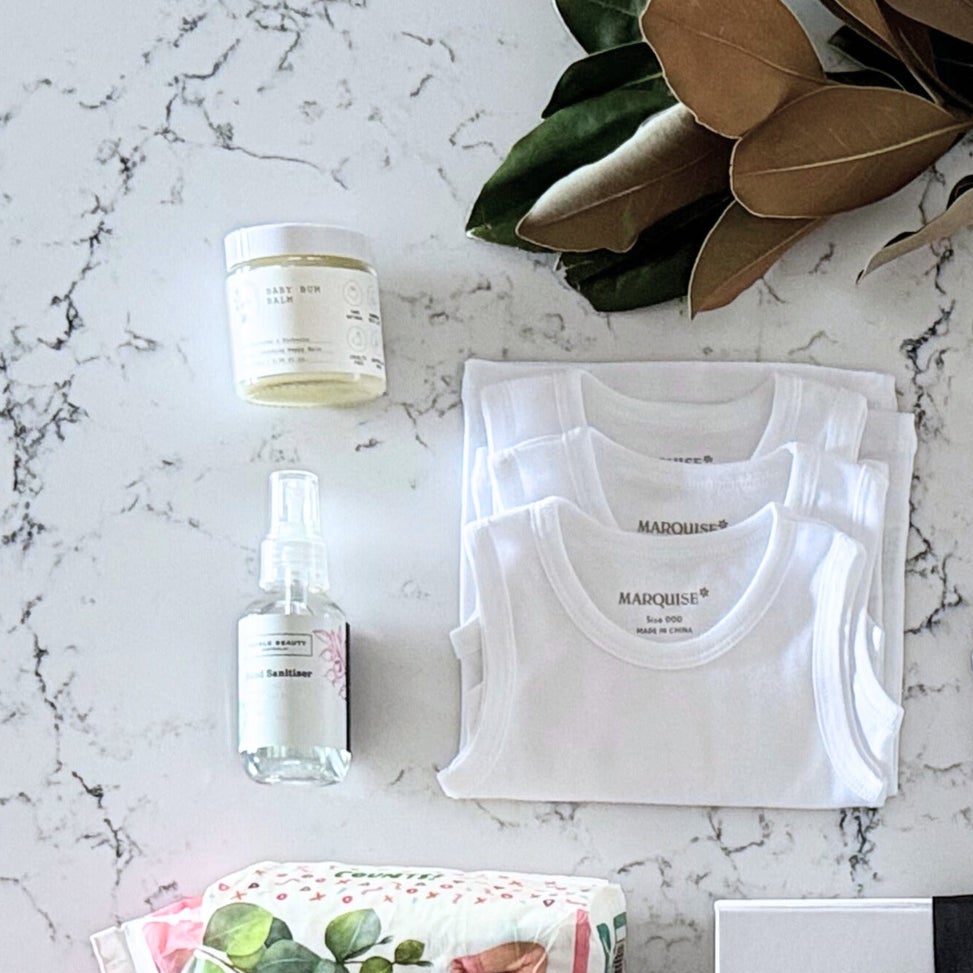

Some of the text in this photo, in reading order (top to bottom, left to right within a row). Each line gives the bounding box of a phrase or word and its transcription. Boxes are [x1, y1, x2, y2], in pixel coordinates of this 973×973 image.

[265, 285, 321, 295] BABY BUM
[266, 296, 293, 304] BALM
[618, 592, 699, 609] MARQUISE
[636, 627, 657, 635] MADE
[266, 669, 312, 678] Sanitiser
